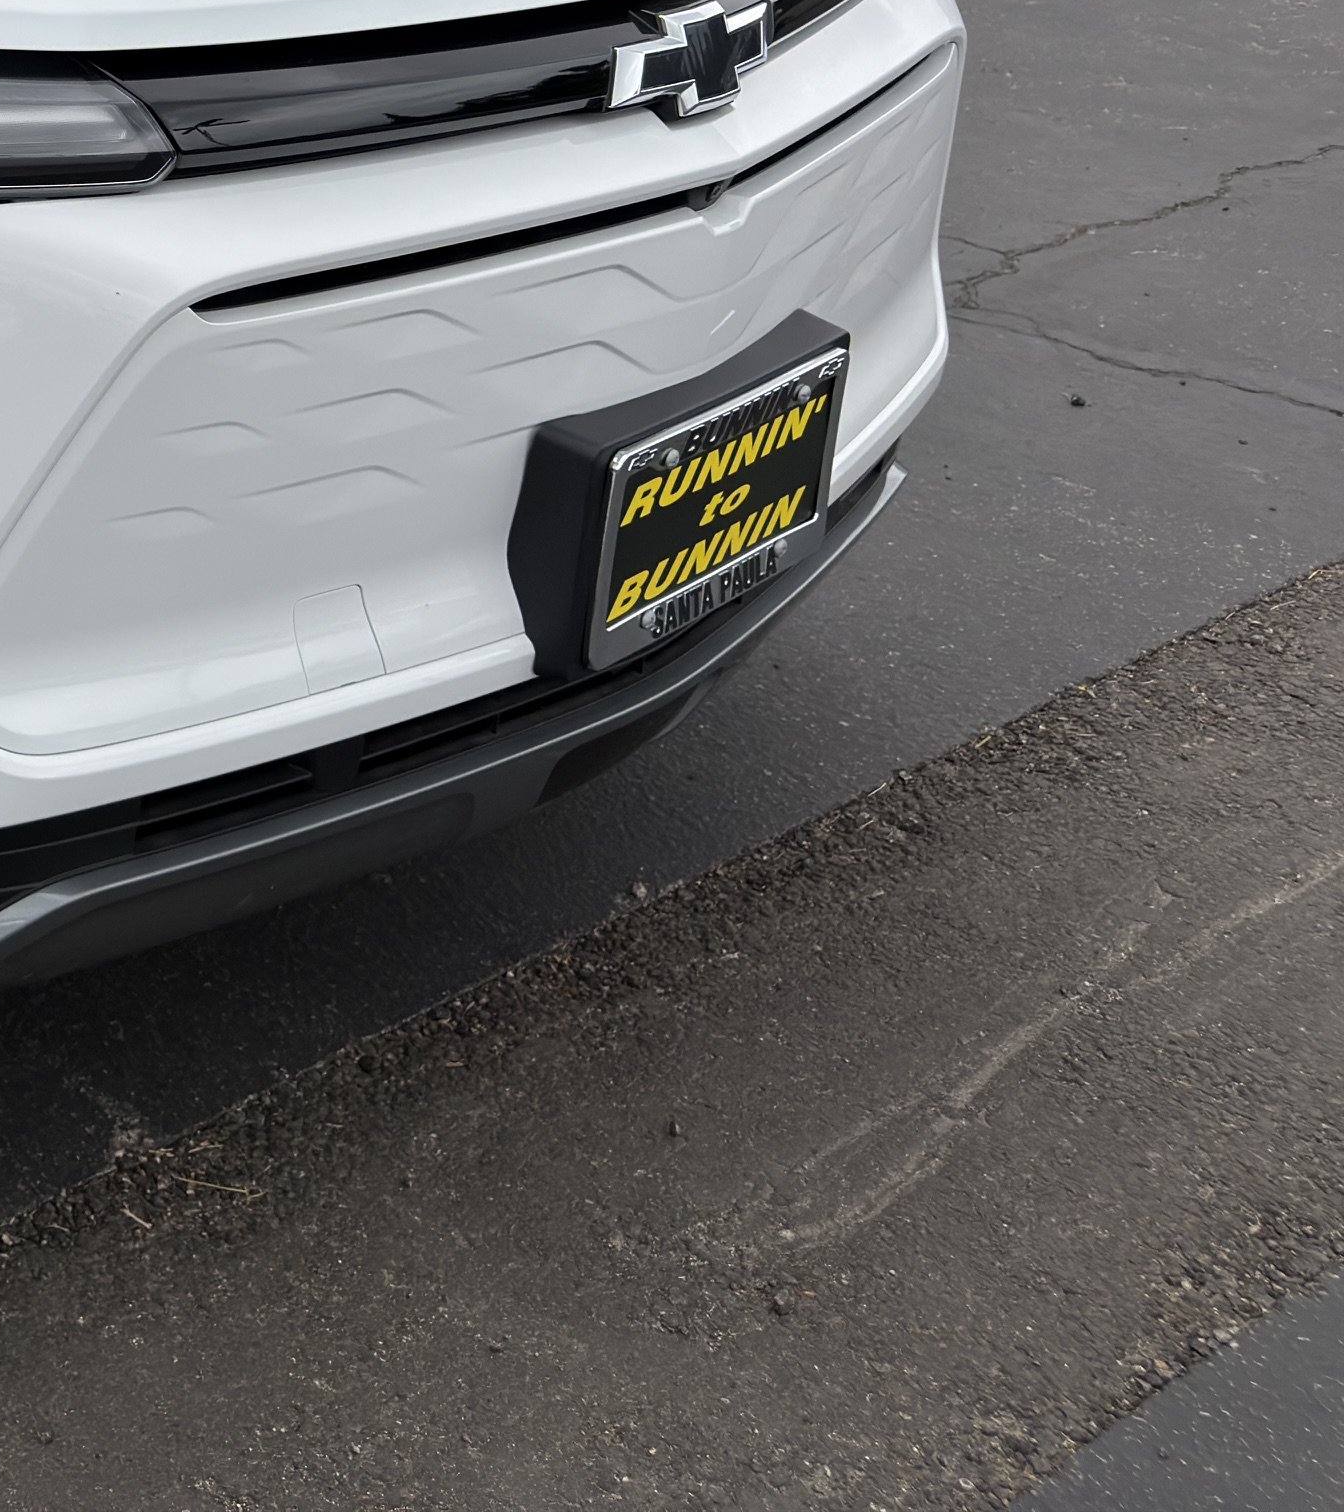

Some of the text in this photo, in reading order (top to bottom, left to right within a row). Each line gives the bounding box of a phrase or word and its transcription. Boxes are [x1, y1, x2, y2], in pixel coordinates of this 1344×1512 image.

[619, 393, 828, 528] RUNNIN'
[698, 483, 751, 527] to
[606, 484, 807, 624] BUNNIN
[650, 544, 778, 639] SANTA PAULA
